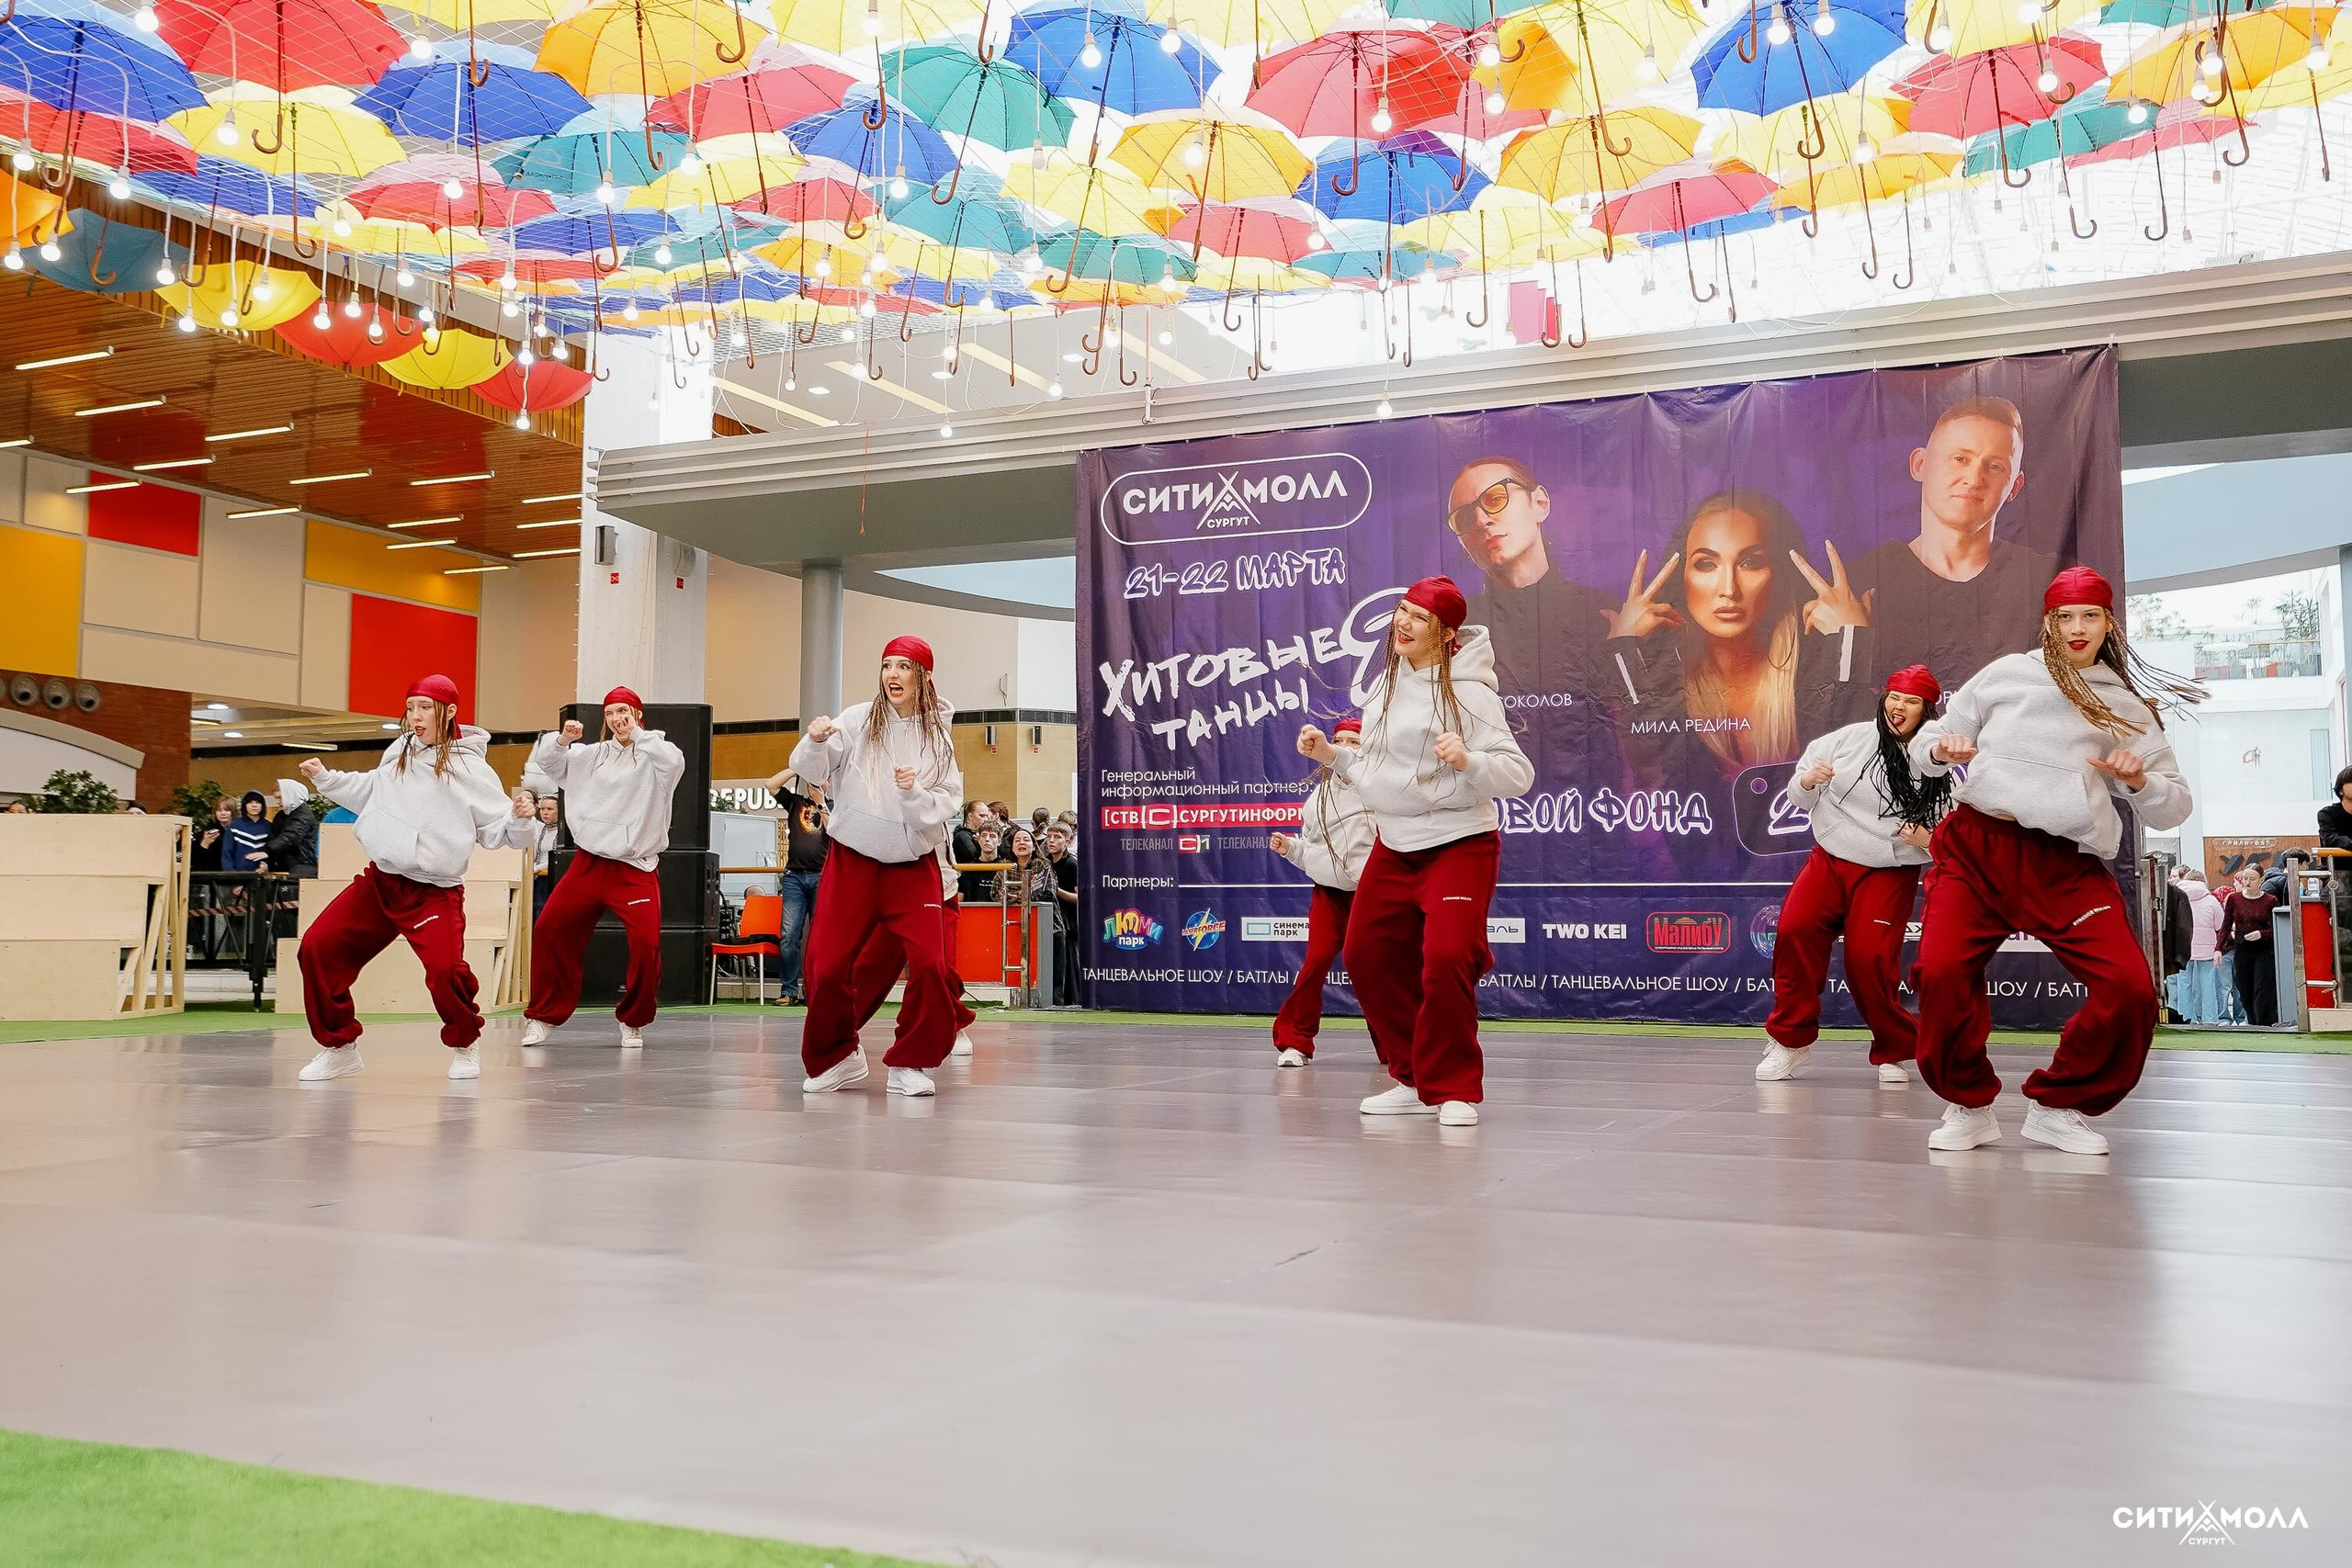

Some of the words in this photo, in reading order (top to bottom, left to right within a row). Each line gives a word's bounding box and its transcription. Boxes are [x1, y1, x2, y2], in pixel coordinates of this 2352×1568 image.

[1123, 481, 1213, 515] СИТИ
[1243, 470, 1348, 504] МОЛЛ
[1207, 516, 1250, 528] СУРГУТ
[1124, 560, 1228, 599] 21-22
[1236, 548, 1346, 592] МАРТА
[1498, 694, 1572, 708] ОКОЛОВ
[1152, 678, 1309, 750] ТАНЦЫ
[1631, 719, 1680, 735] МИЛА
[1685, 717, 1752, 734] РЕДИНА
[1102, 766, 1195, 784] Генеральный
[1102, 782, 1239, 799] информационный
[1244, 781, 1314, 797] партнер:
[1589, 787, 1713, 835] ФОНД
[1120, 836, 1173, 851] ТЕЛЕКАНАЛ
[1102, 875, 1174, 890] Партнеры:
[1273, 921, 1310, 930] синема
[1273, 929, 1299, 938] парк
[1543, 923, 1589, 940] TWO
[1593, 923, 1627, 940] KEI
[1118, 936, 1145, 947] парк
[1082, 967, 1184, 983] ТАНЦЕВАЛЬНОЕ
[1188, 969, 1224, 984] ШОУ
[1237, 970, 1289, 984] БАТТЛЫ
[1552, 975, 1681, 991] ТАНЦЕВАЛЬНОЕ
[1687, 977, 1728, 992] ШОУ
